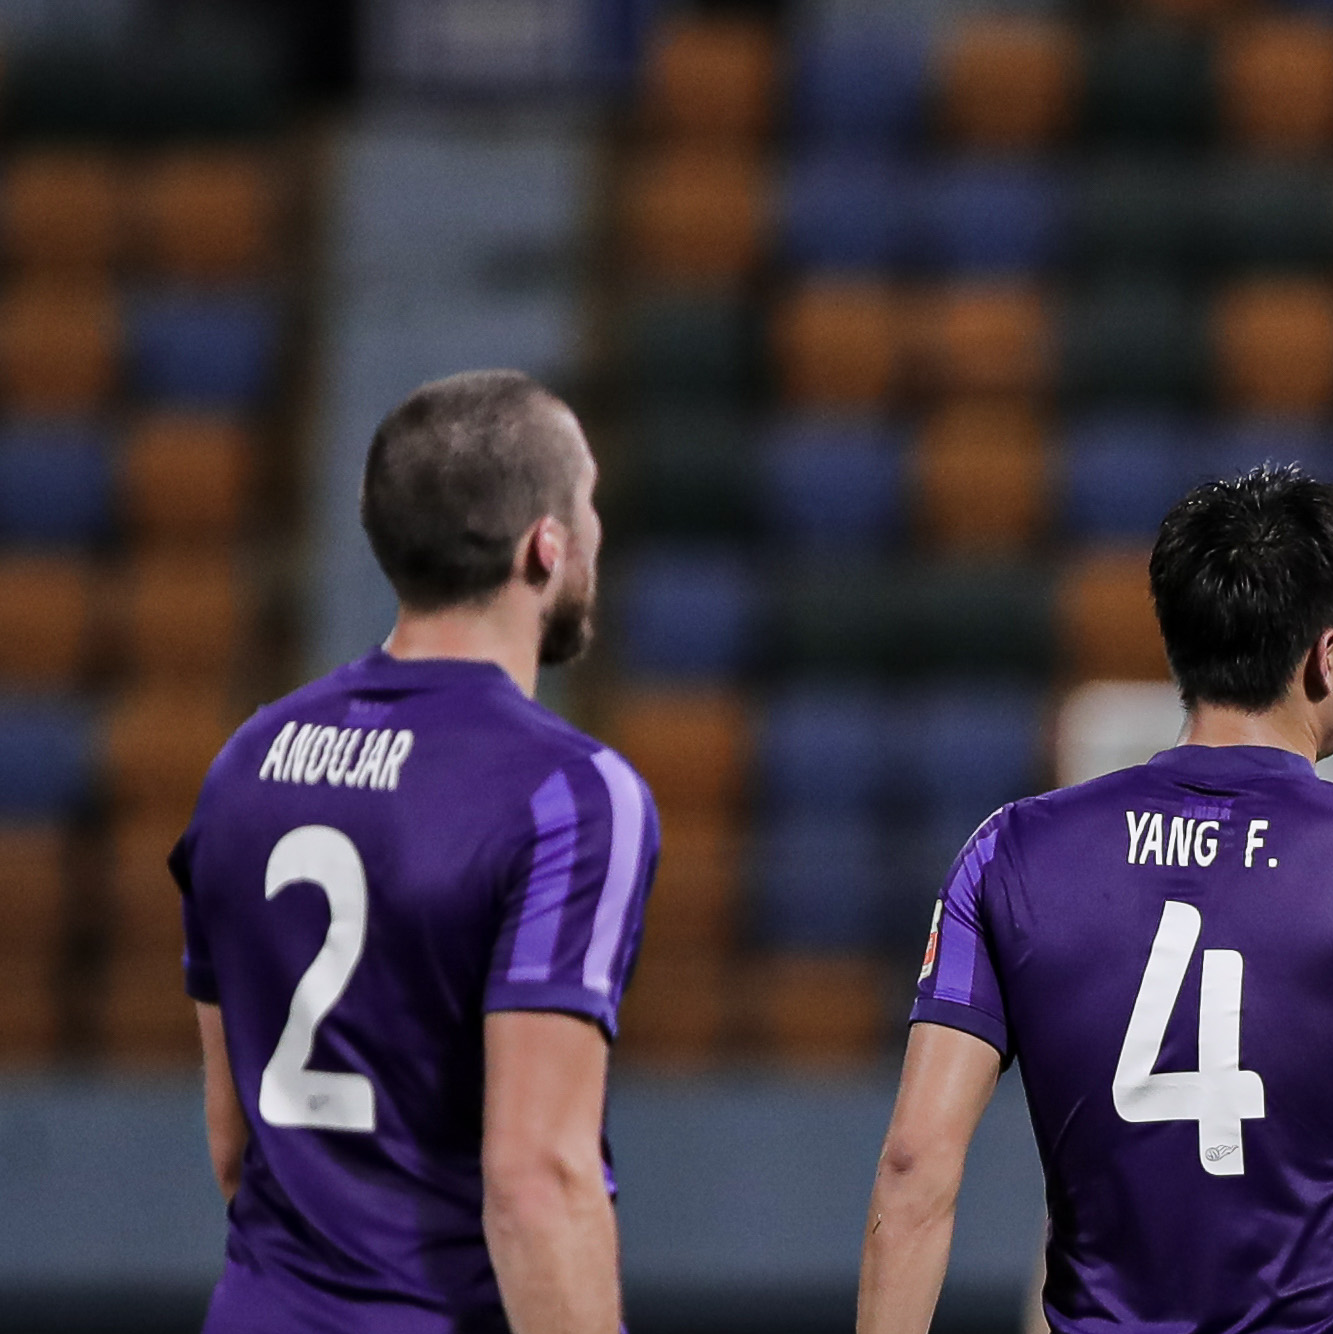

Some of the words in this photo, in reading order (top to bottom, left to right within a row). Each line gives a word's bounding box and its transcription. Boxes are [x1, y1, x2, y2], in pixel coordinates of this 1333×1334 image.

[258, 720, 414, 792] ANDUJAR
[1125, 810, 1220, 868] YANG
[1243, 818, 1279, 869] F.
[259, 824, 376, 1132] 2
[1112, 900, 1265, 1176] 4
